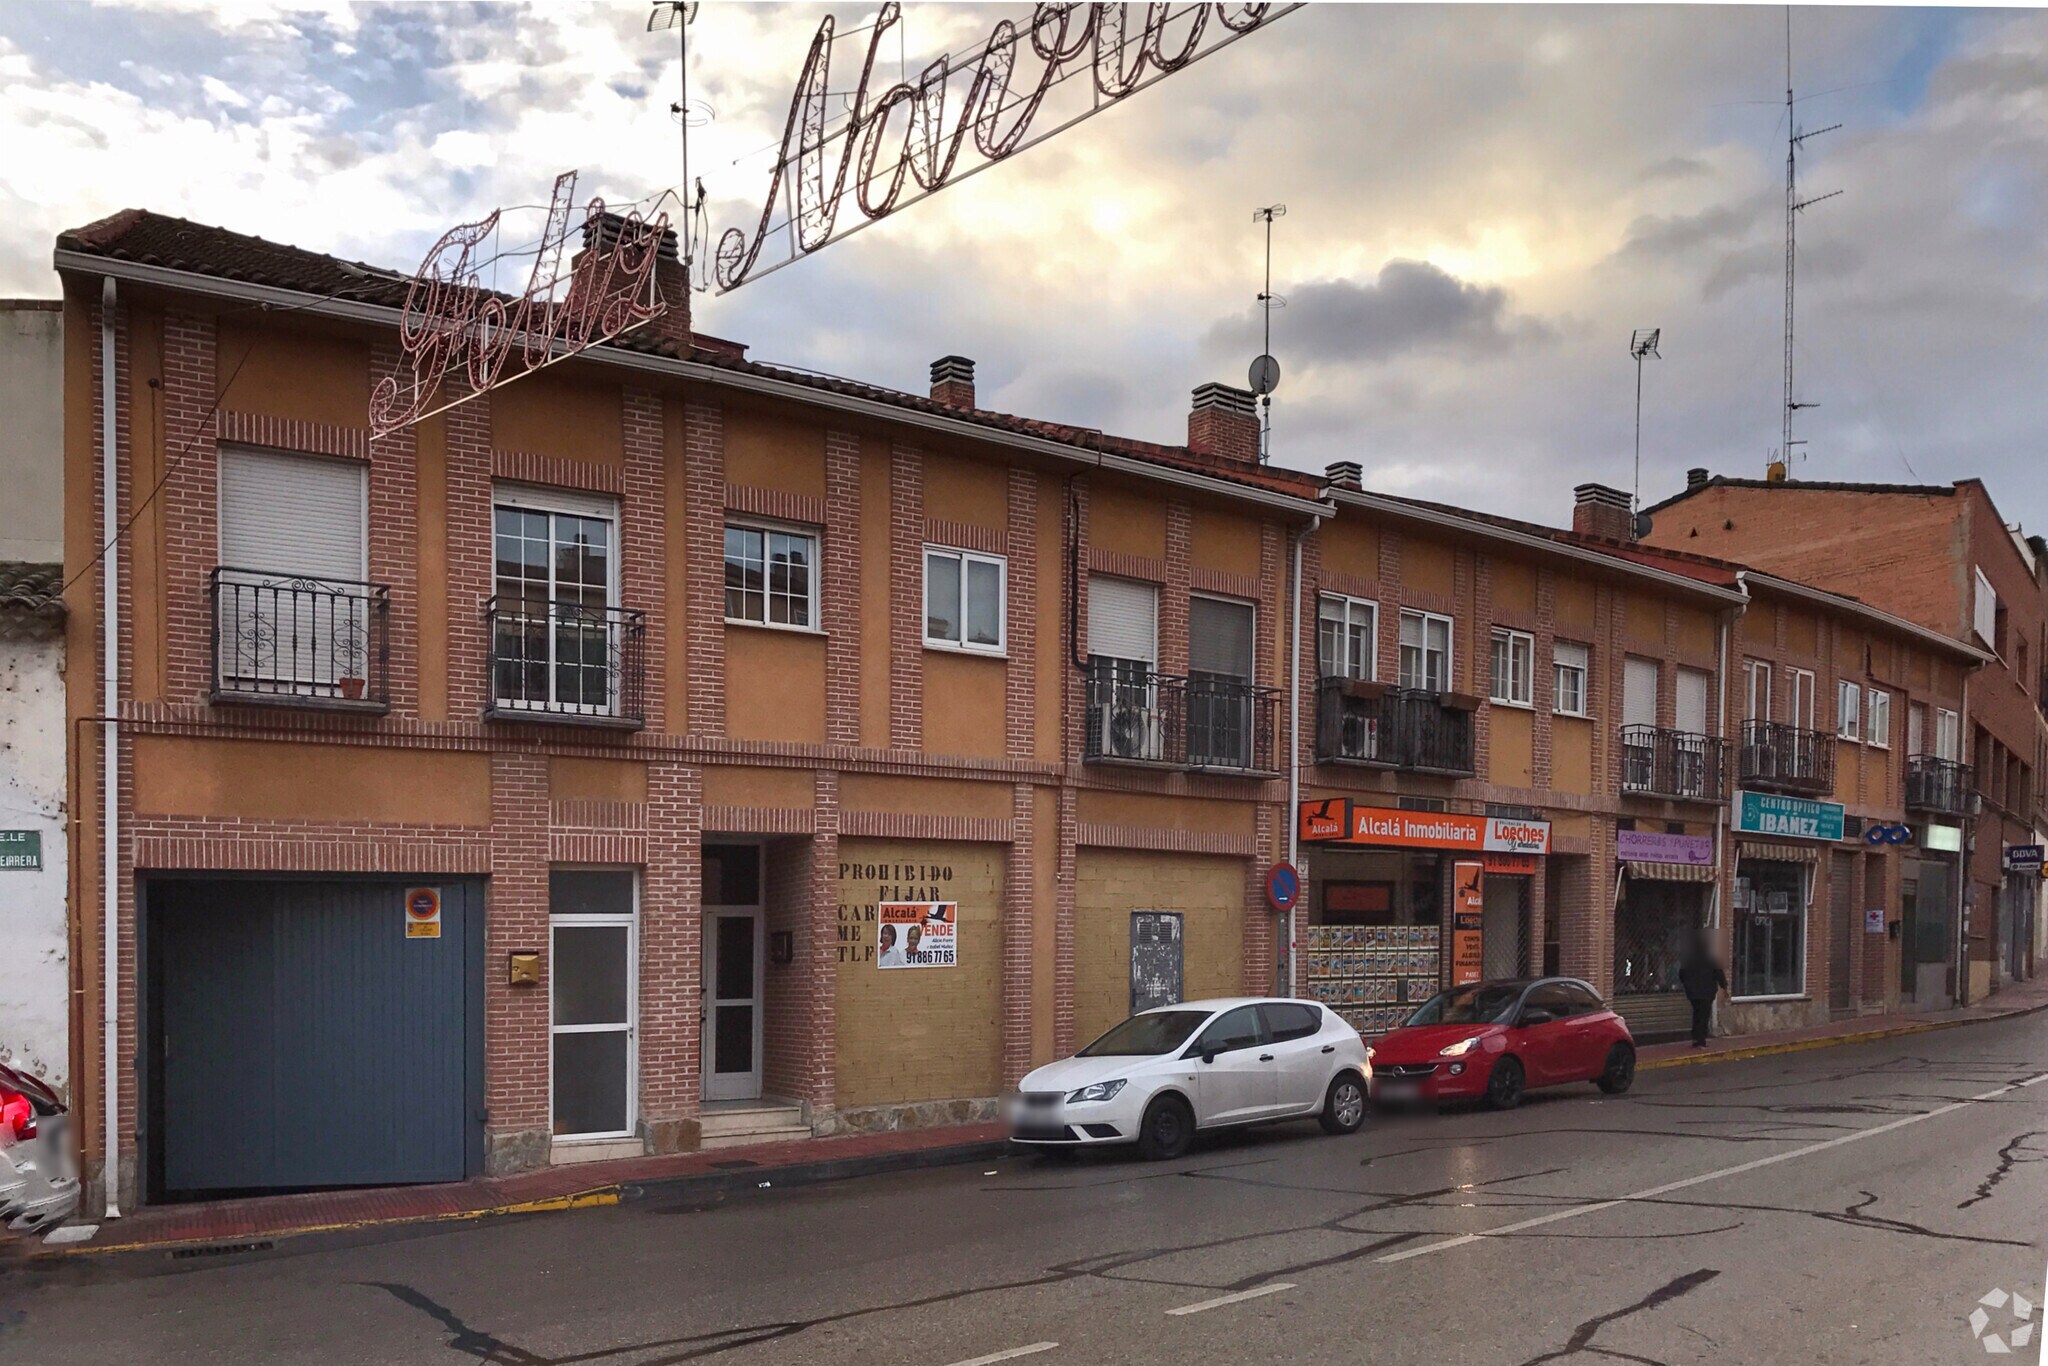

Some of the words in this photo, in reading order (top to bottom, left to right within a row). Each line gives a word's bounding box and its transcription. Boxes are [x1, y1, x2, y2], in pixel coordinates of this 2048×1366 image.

[1760, 797, 1791, 811] CENTRO
[1312, 822, 1339, 834] Alcalá
[1358, 816, 1400, 837] Alcalá
[1404, 819, 1477, 841] Inmobiliaria
[1494, 820, 1545, 843] Loeches
[1760, 812, 1819, 837] IBÁÑEZ
[2012, 849, 2038, 858] BBVA
[838, 863, 953, 881] PROHIBIDO
[880, 885, 940, 901] FIJAR
[883, 907, 917, 918] Alcalá
[838, 925, 861, 941] ME
[919, 925, 953, 936] VENDE
